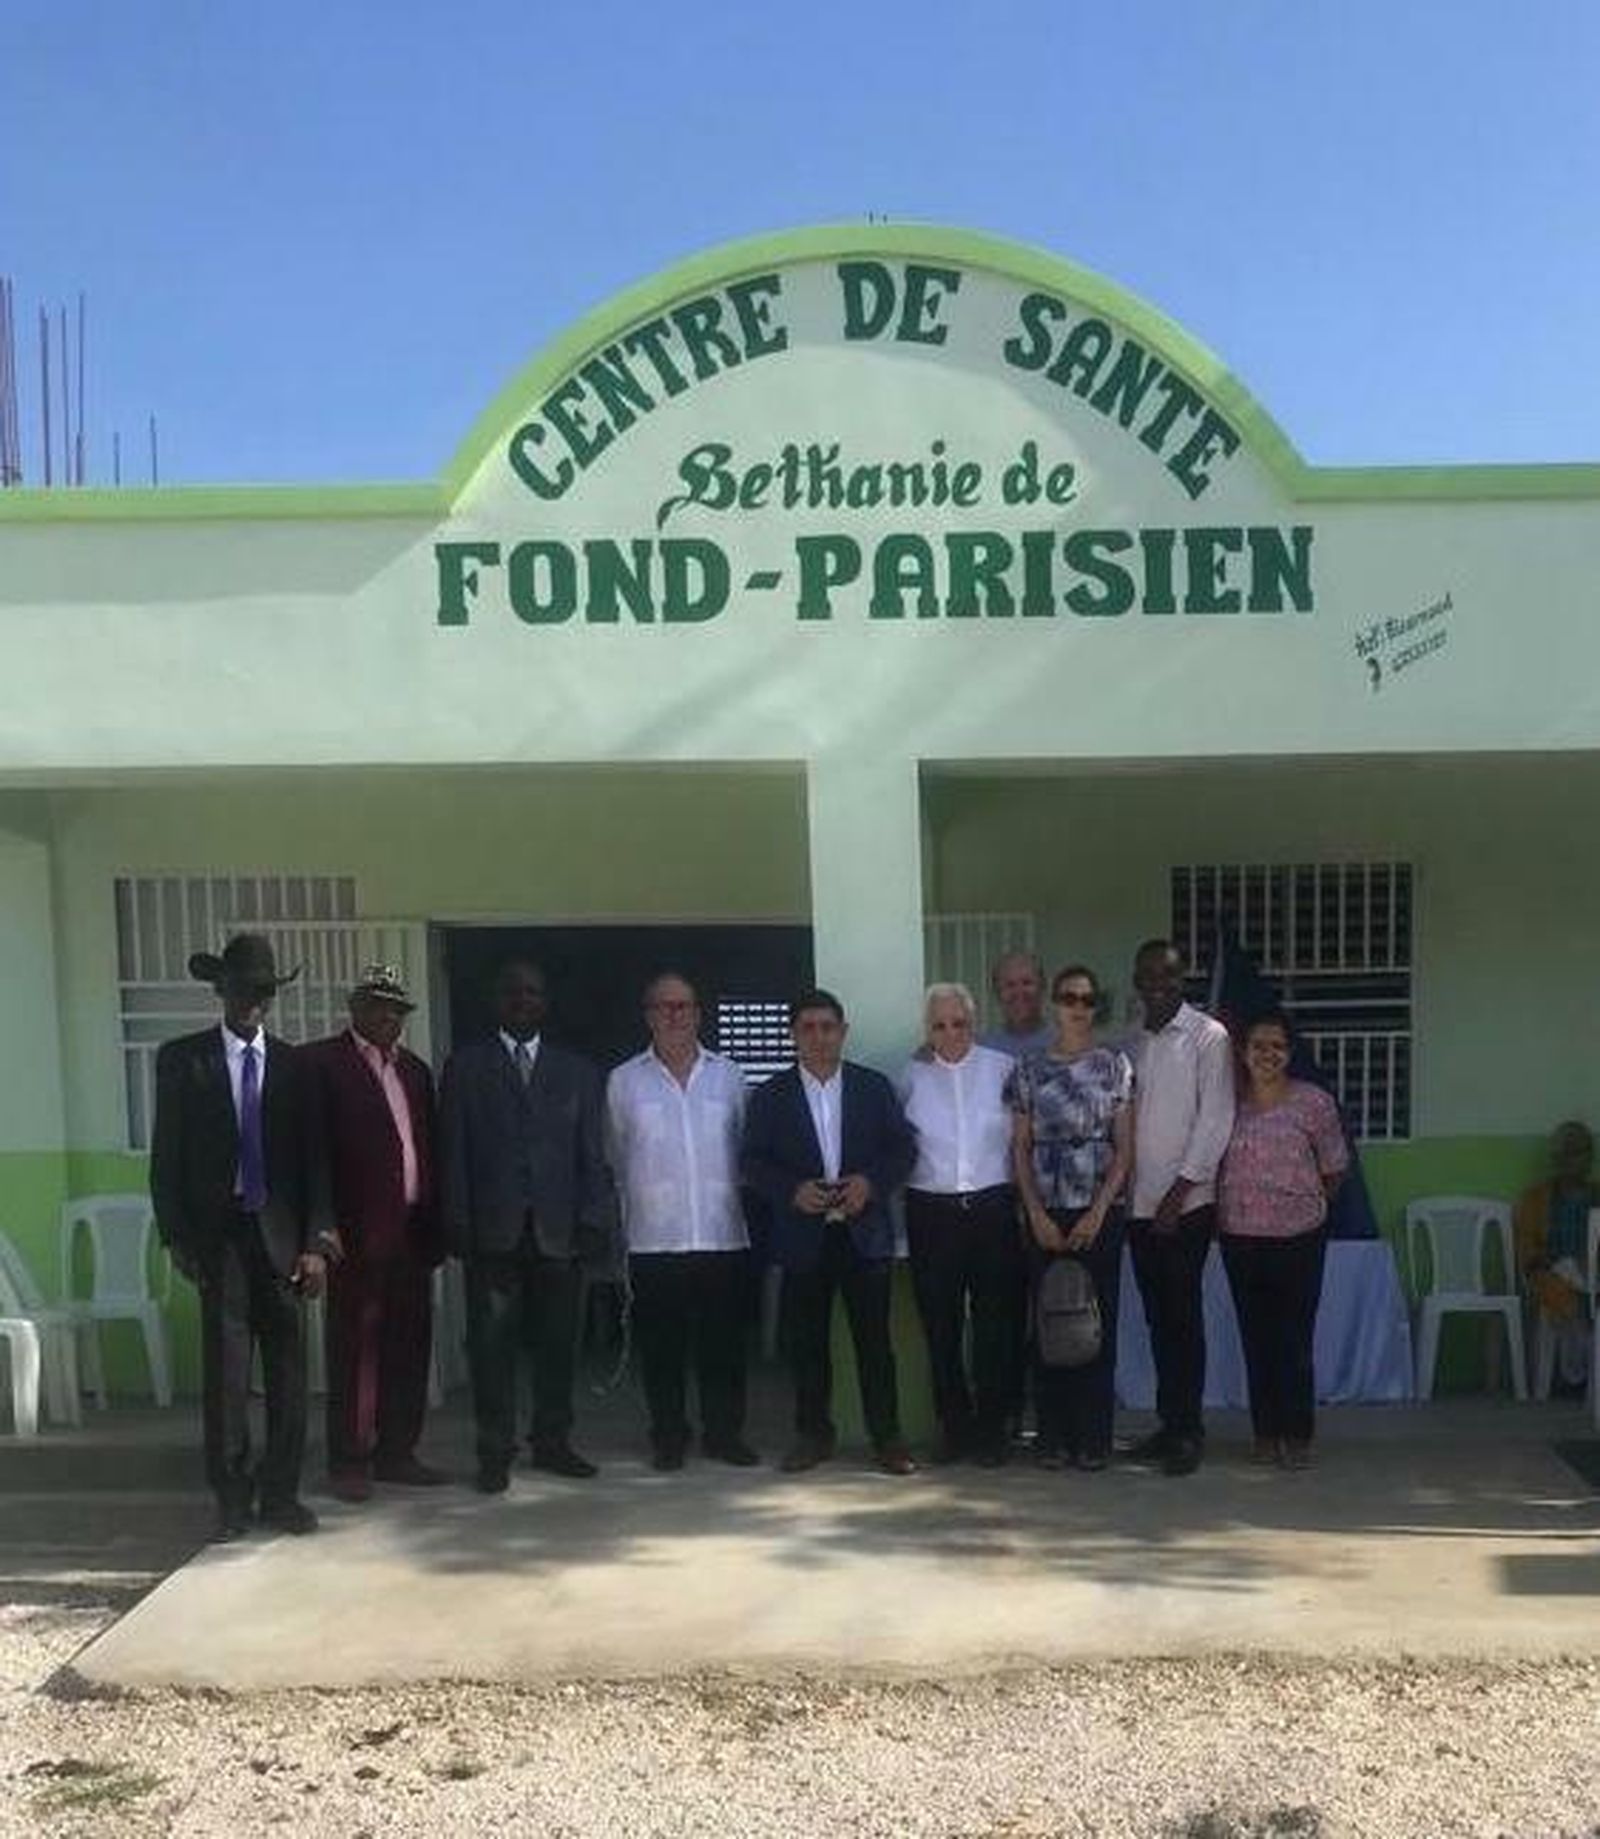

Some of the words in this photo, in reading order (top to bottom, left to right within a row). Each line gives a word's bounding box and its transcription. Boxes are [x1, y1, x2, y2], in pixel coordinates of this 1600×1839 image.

[508, 274, 787, 500] CENTRE
[838, 261, 961, 345] DE
[1004, 293, 1241, 500] SANTE
[658, 441, 982, 530] Bethanie
[1002, 441, 1077, 502] de
